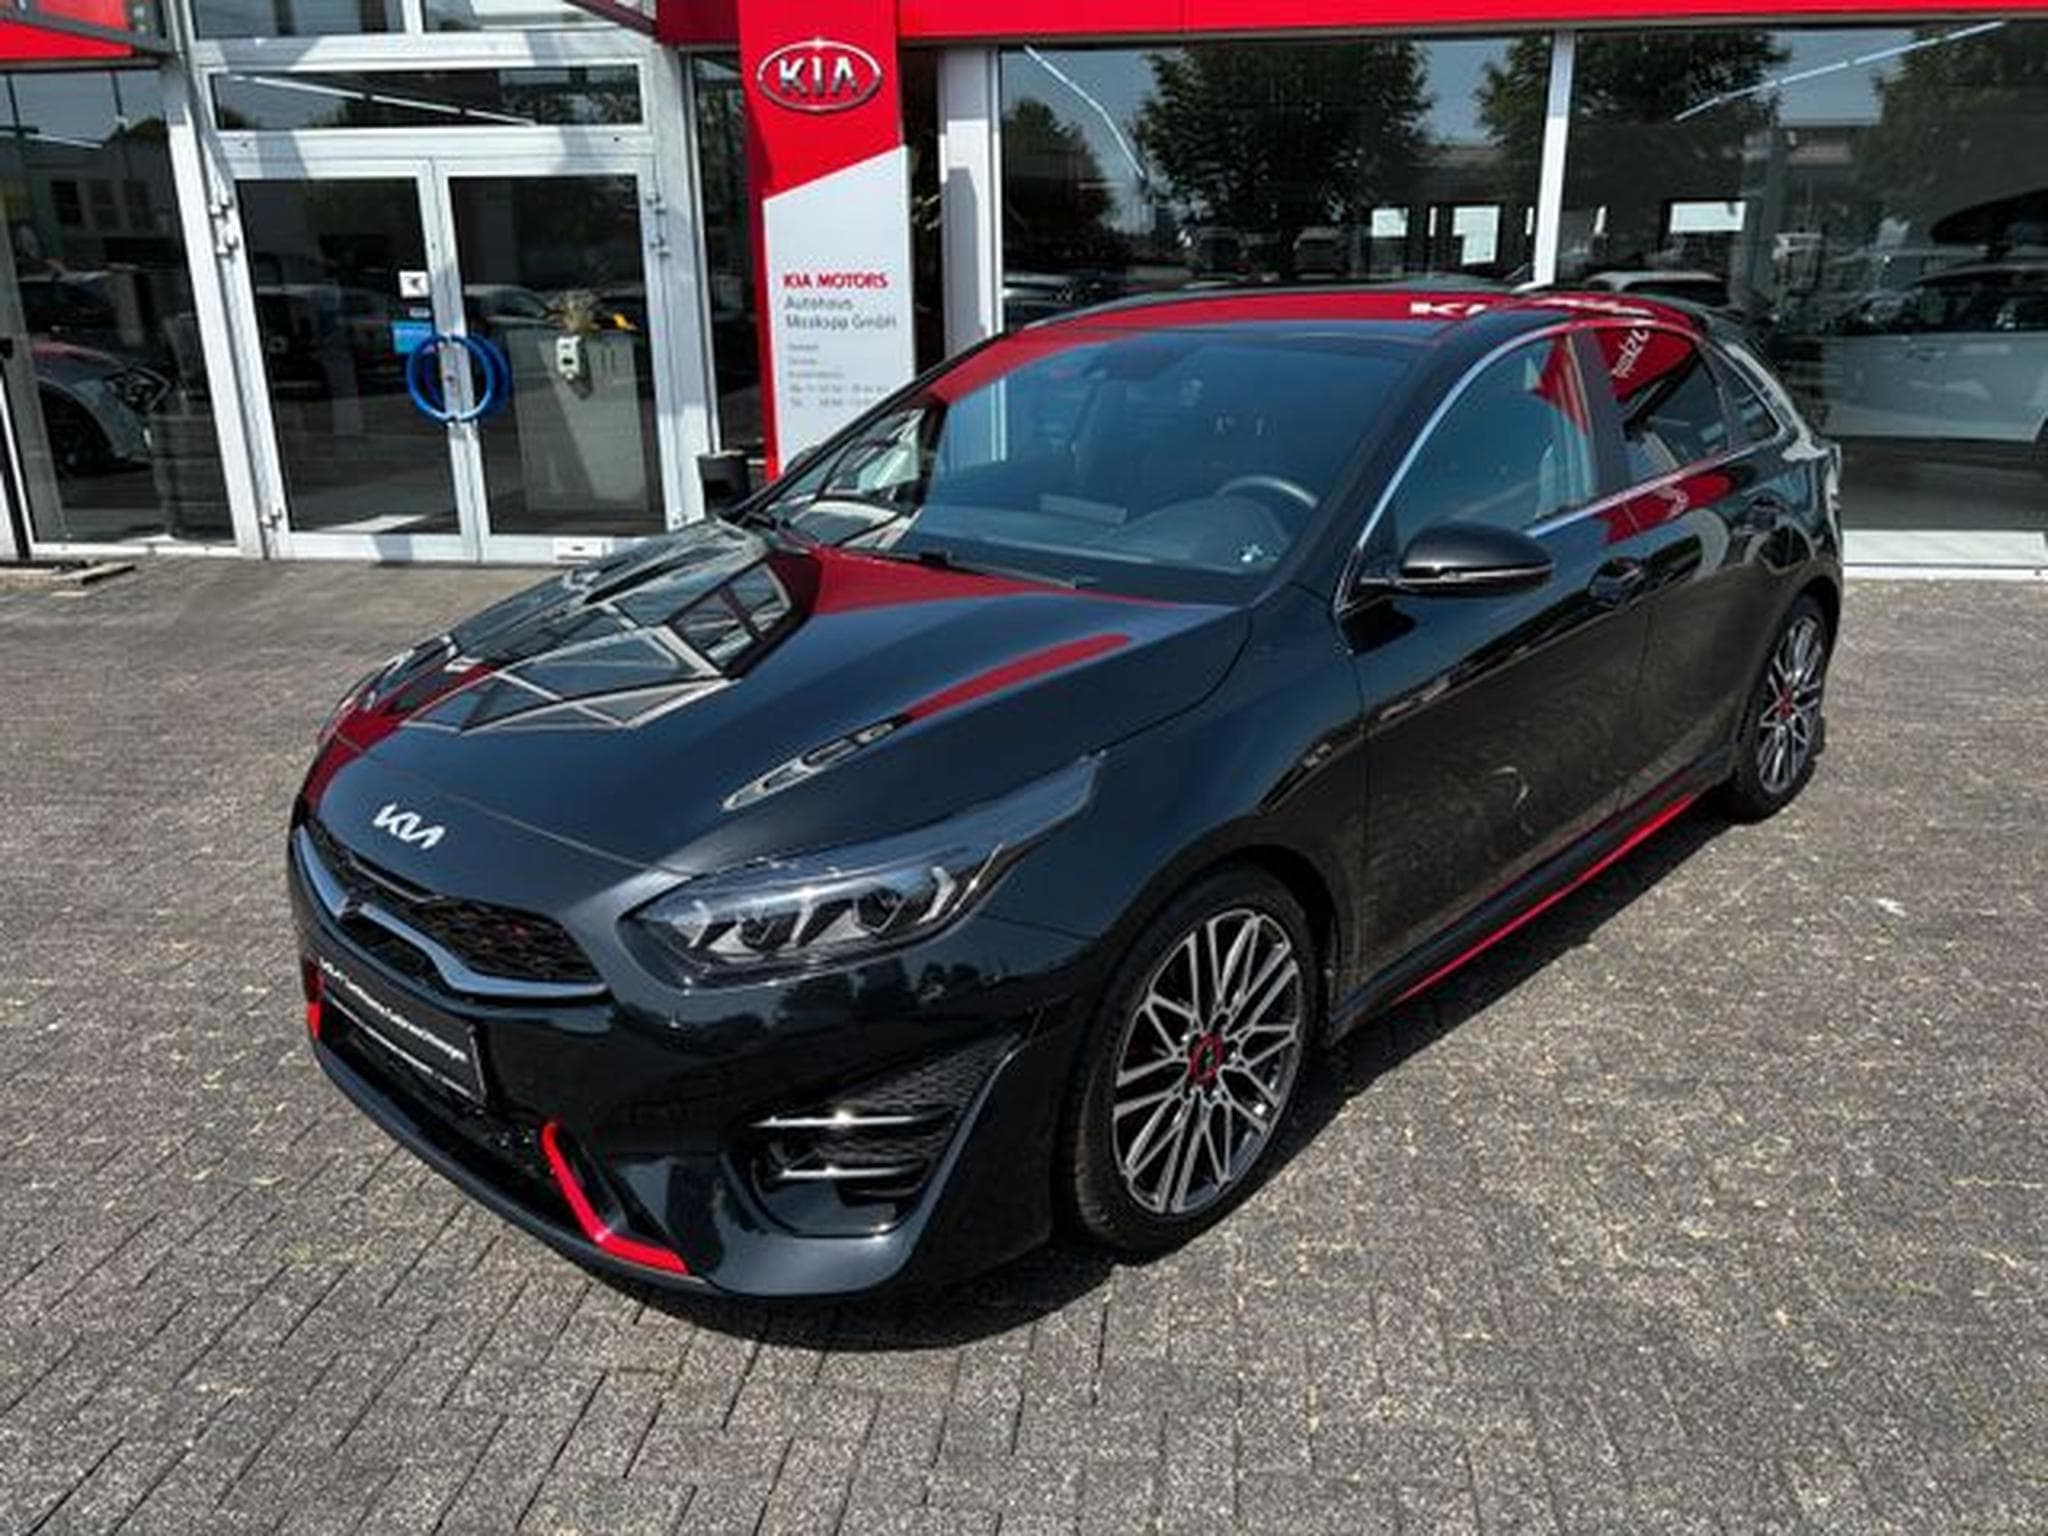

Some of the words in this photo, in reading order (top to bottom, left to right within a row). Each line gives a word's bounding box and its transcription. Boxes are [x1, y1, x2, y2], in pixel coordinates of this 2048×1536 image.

[779, 56, 857, 95] KIA
[783, 272, 812, 289] KIA
[817, 272, 888, 289] MOTORS
[785, 295, 853, 311] Autohaus
[851, 313, 897, 330] GmbH
[373, 802, 445, 849] KIA
